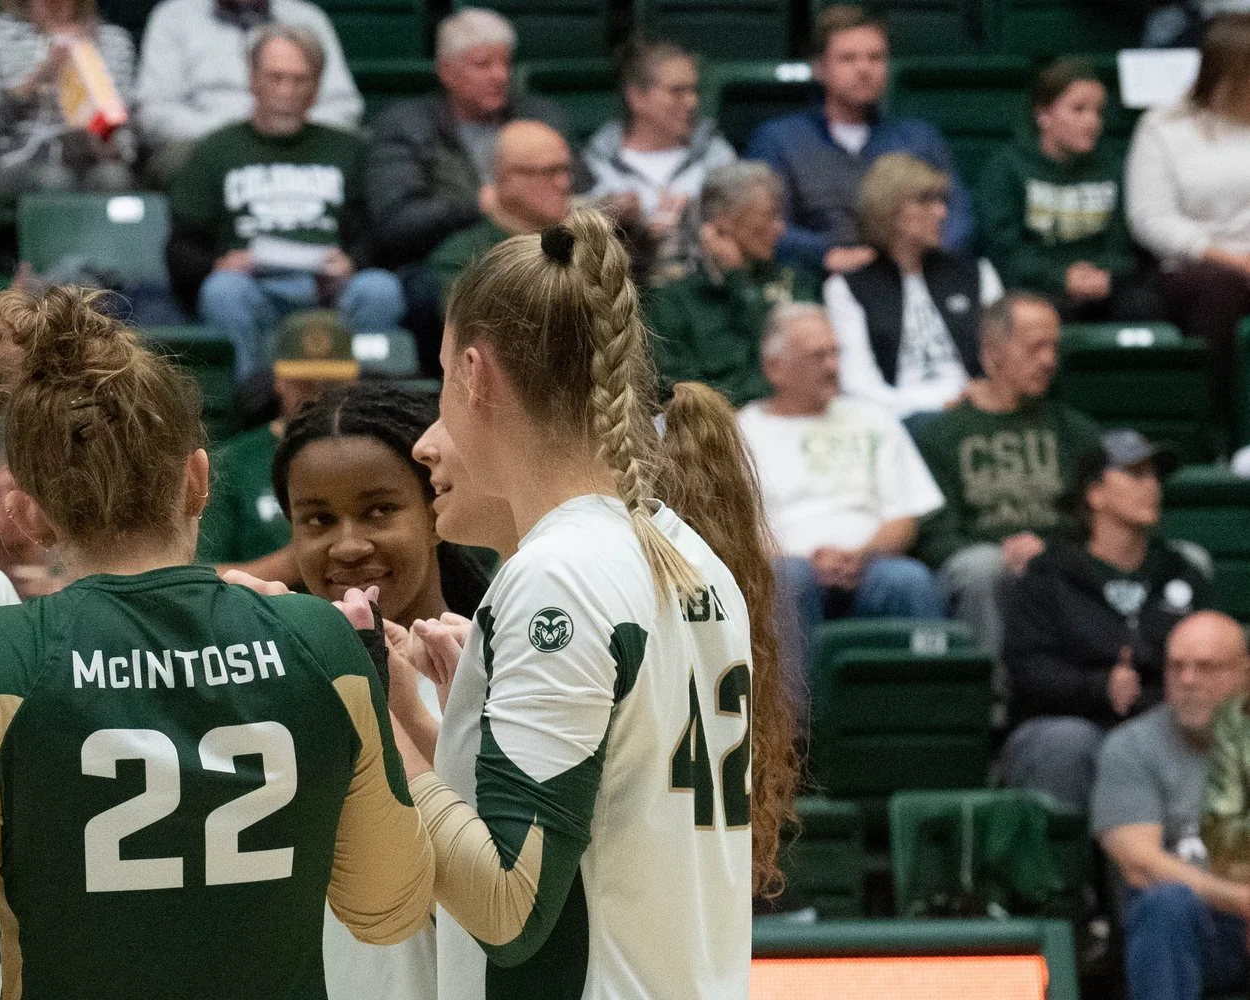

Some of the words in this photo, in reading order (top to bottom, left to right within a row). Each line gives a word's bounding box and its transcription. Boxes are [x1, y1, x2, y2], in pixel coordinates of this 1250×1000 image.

[958, 428, 1059, 474] CSU
[71, 639, 287, 690] McINTOSH
[667, 655, 753, 833] 42
[79, 720, 299, 893] 22
